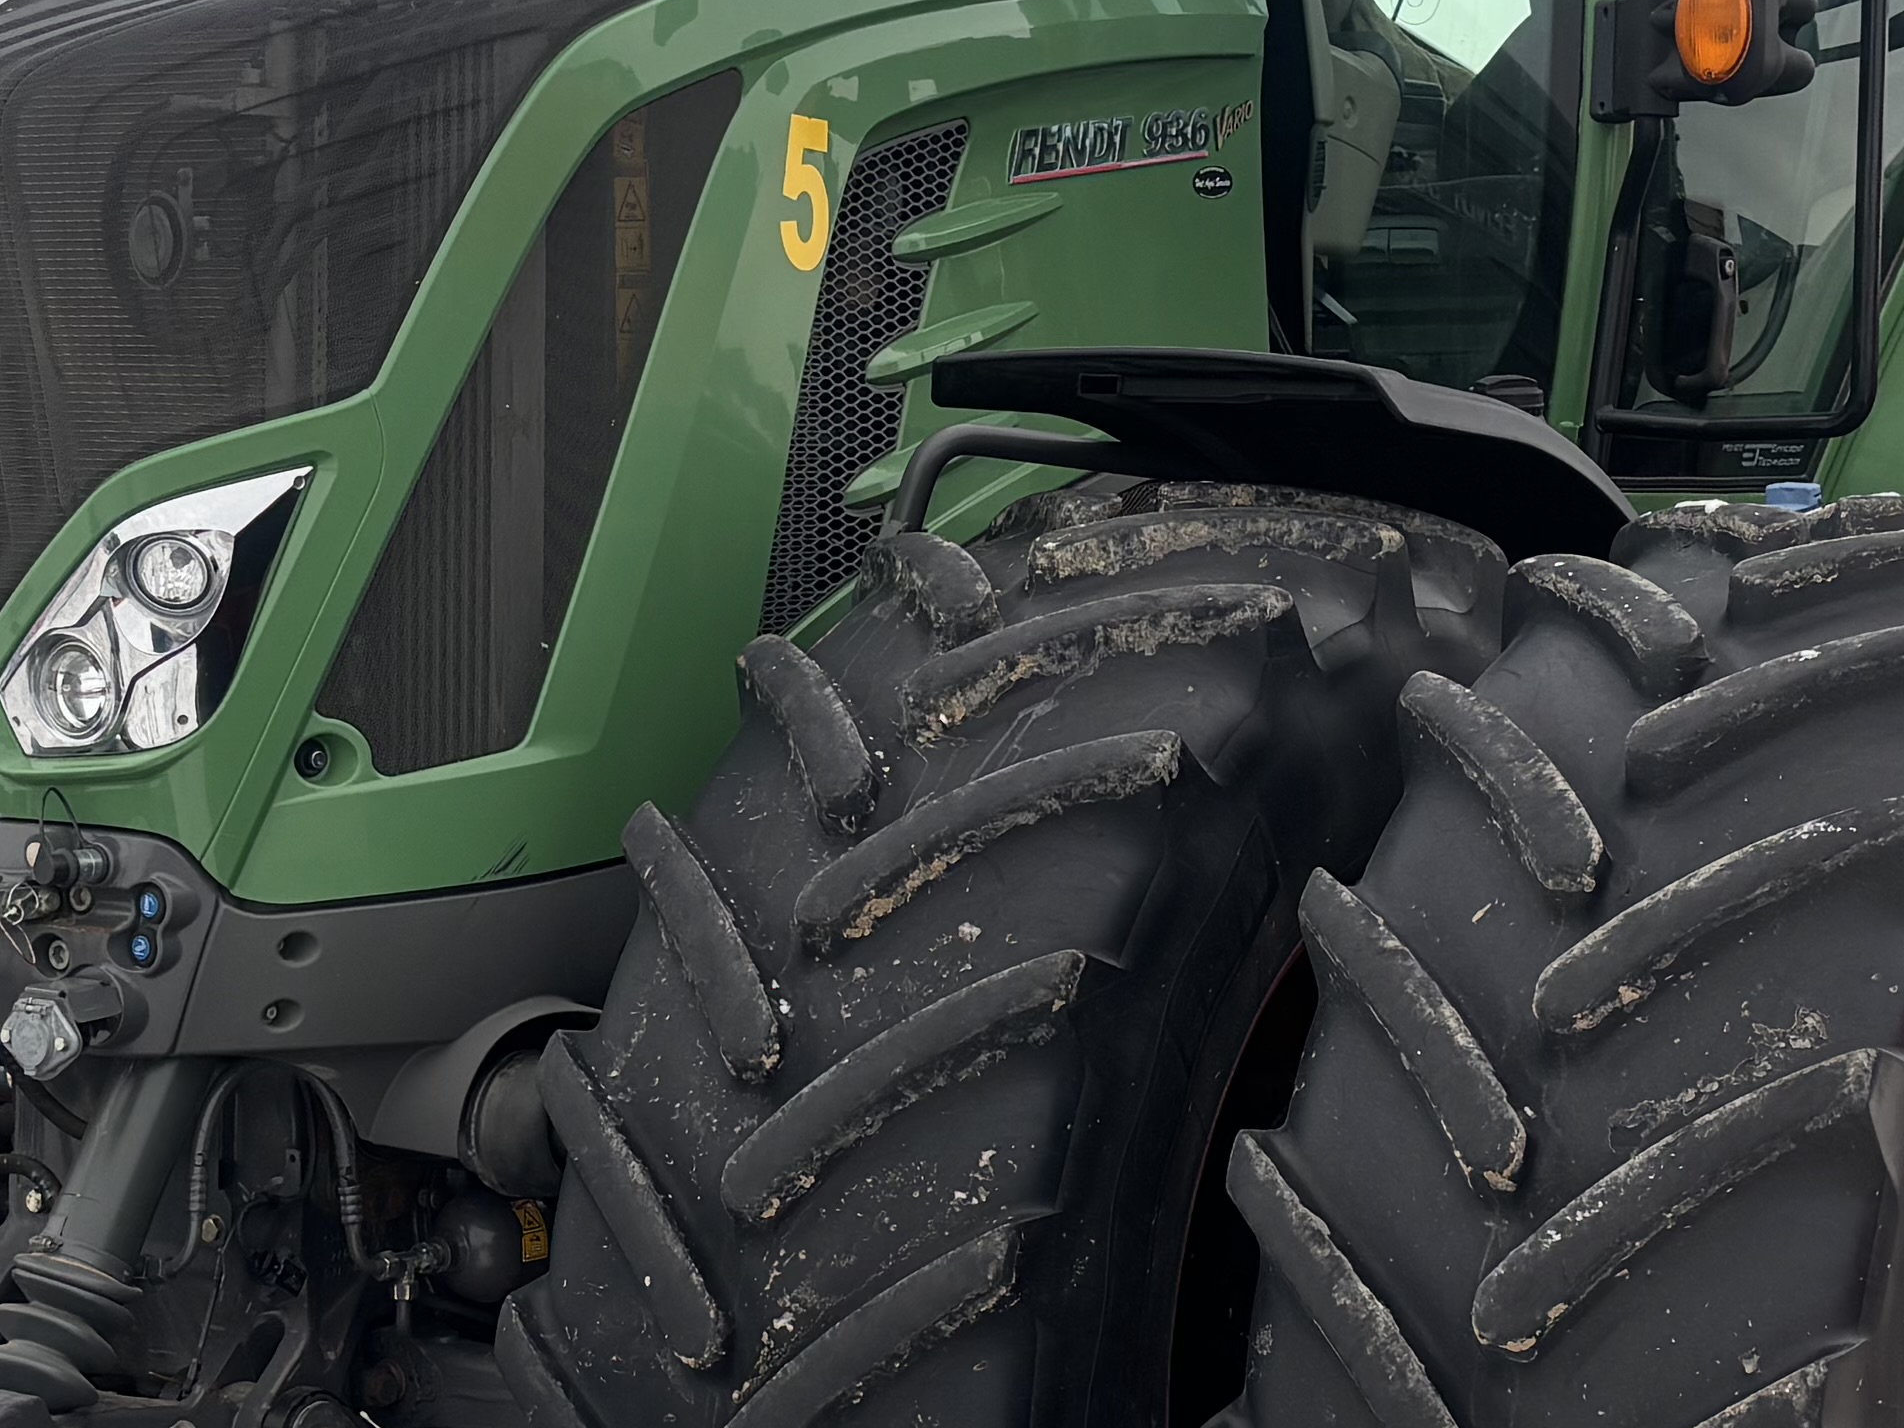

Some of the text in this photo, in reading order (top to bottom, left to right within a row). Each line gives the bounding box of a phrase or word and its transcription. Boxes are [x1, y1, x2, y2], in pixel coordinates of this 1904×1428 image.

[780, 114, 831, 271] 5
[1008, 99, 1254, 183] FENDT 936 VARIO
